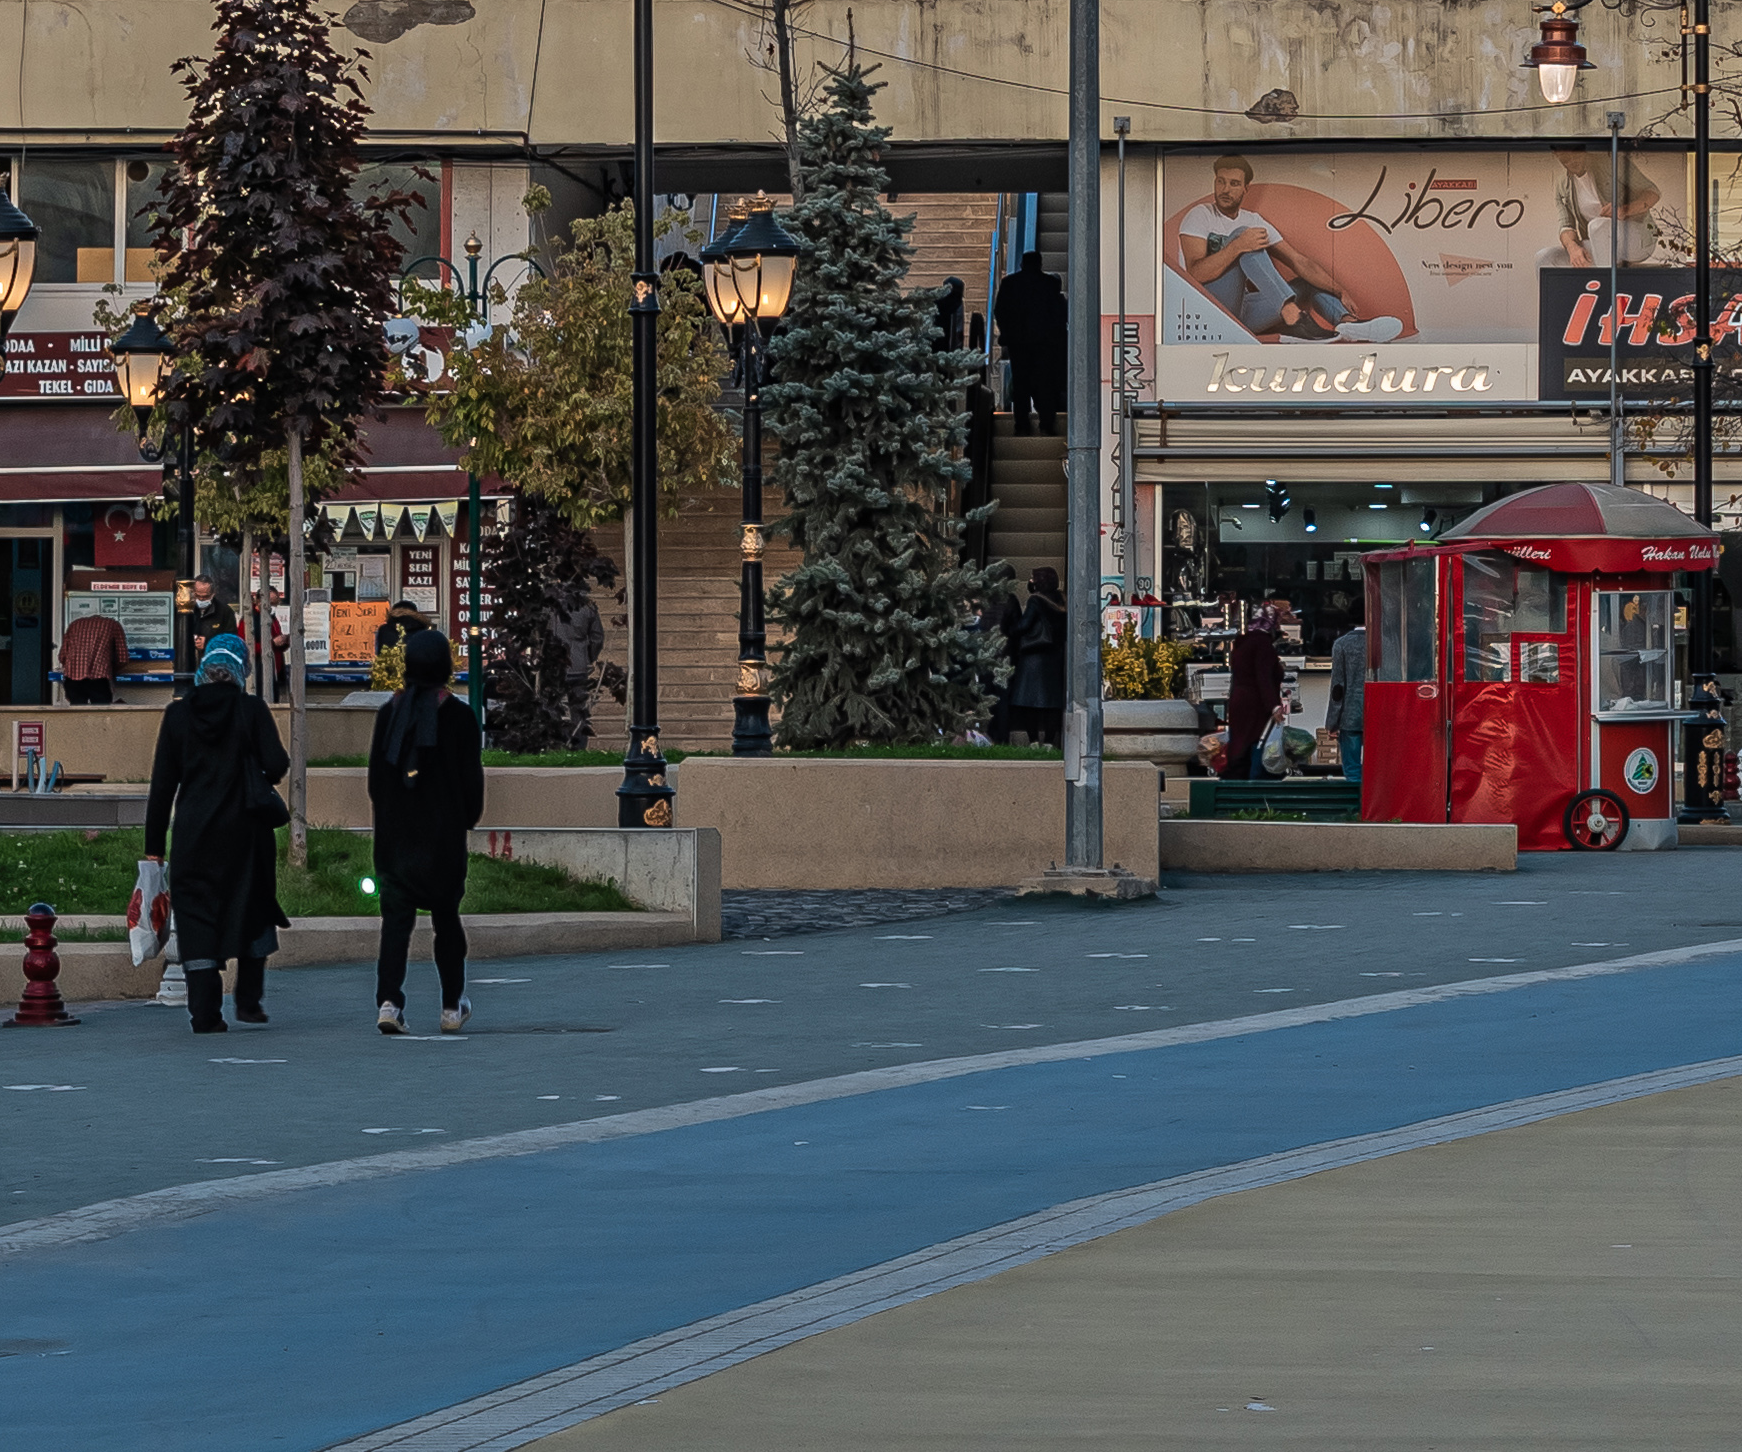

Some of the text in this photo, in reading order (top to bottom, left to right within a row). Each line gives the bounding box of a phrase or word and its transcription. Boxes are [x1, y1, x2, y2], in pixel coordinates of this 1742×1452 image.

[1431, 180, 1477, 190] AYAKKABI
[1327, 164, 1525, 235] Libero
[1421, 260, 1440, 269] New
[1442, 260, 1472, 272] design
[1496, 262, 1514, 272] you
[70, 335, 101, 352] MİLLİ
[27, 359, 67, 373] KAZAN
[1207, 351, 1494, 394] kundura
[1566, 368, 1696, 385] AYAKKAB
[39, 380, 114, 394] TEKEL GIDA
[409, 549, 432, 560] YENİ
[1641, 546, 1685, 562] Hakan
[409, 563, 432, 573] SERİ
[408, 576, 433, 585] KAZI
